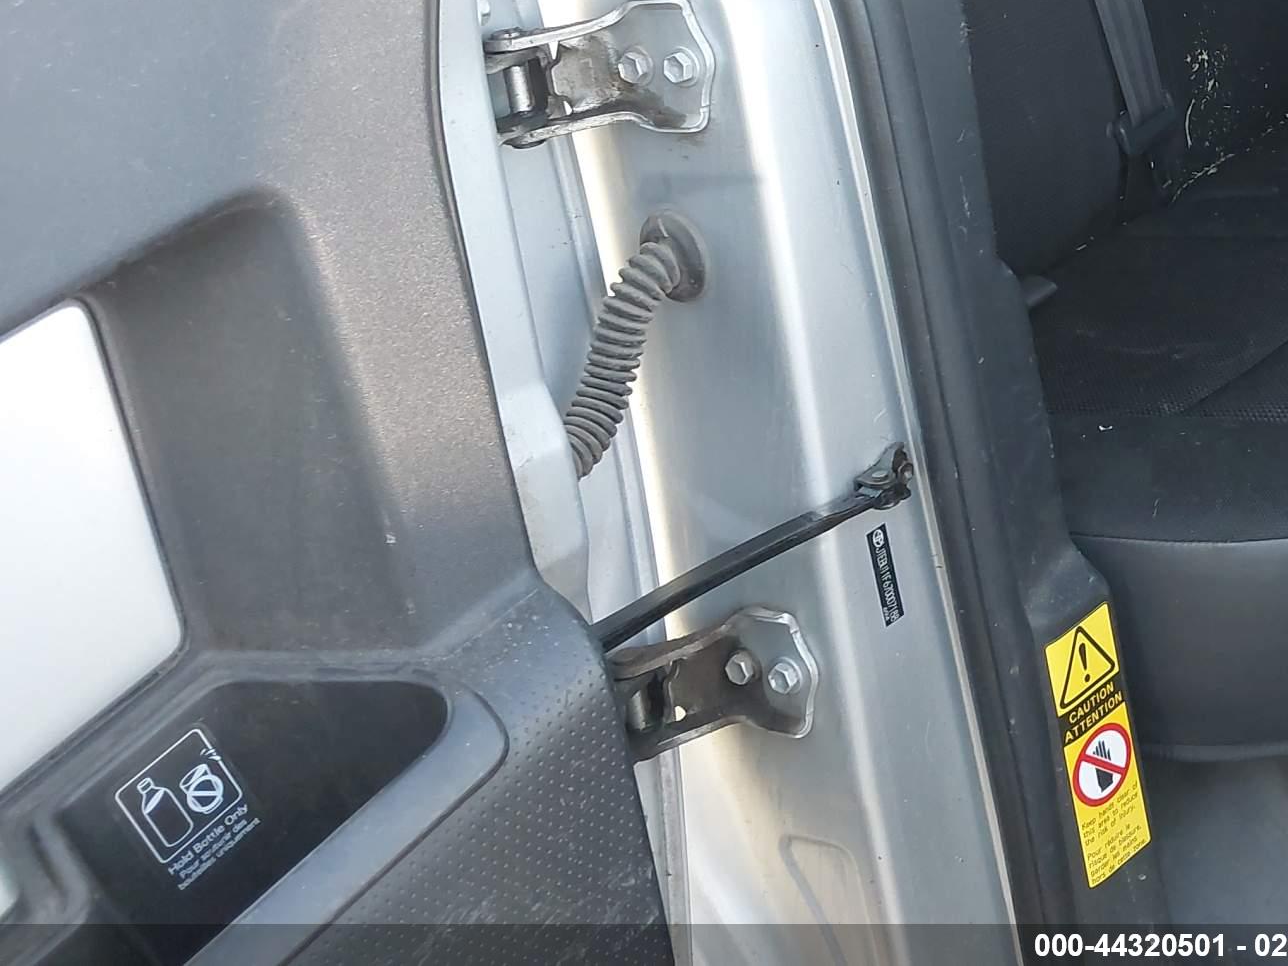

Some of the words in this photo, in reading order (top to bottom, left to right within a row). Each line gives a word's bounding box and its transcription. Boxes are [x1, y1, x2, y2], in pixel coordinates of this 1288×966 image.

[1069, 681, 1114, 724] CAUTION
[1065, 690, 1123, 744] ATTENTION
[1081, 817, 1096, 831] Keep
[1083, 827, 1095, 838] this
[1098, 816, 1110, 829] area
[1112, 808, 1119, 817] to
[1120, 792, 1138, 809] reduce
[168, 850, 194, 875] Hold
[192, 825, 225, 854] Bottle
[224, 804, 248, 825] Only
[1085, 836, 1095, 846] the
[1087, 849, 1101, 861] Pour
[1089, 853, 1107, 869] risque
[179, 859, 200, 879] Pour
[1091, 872, 1106, 885] hors
